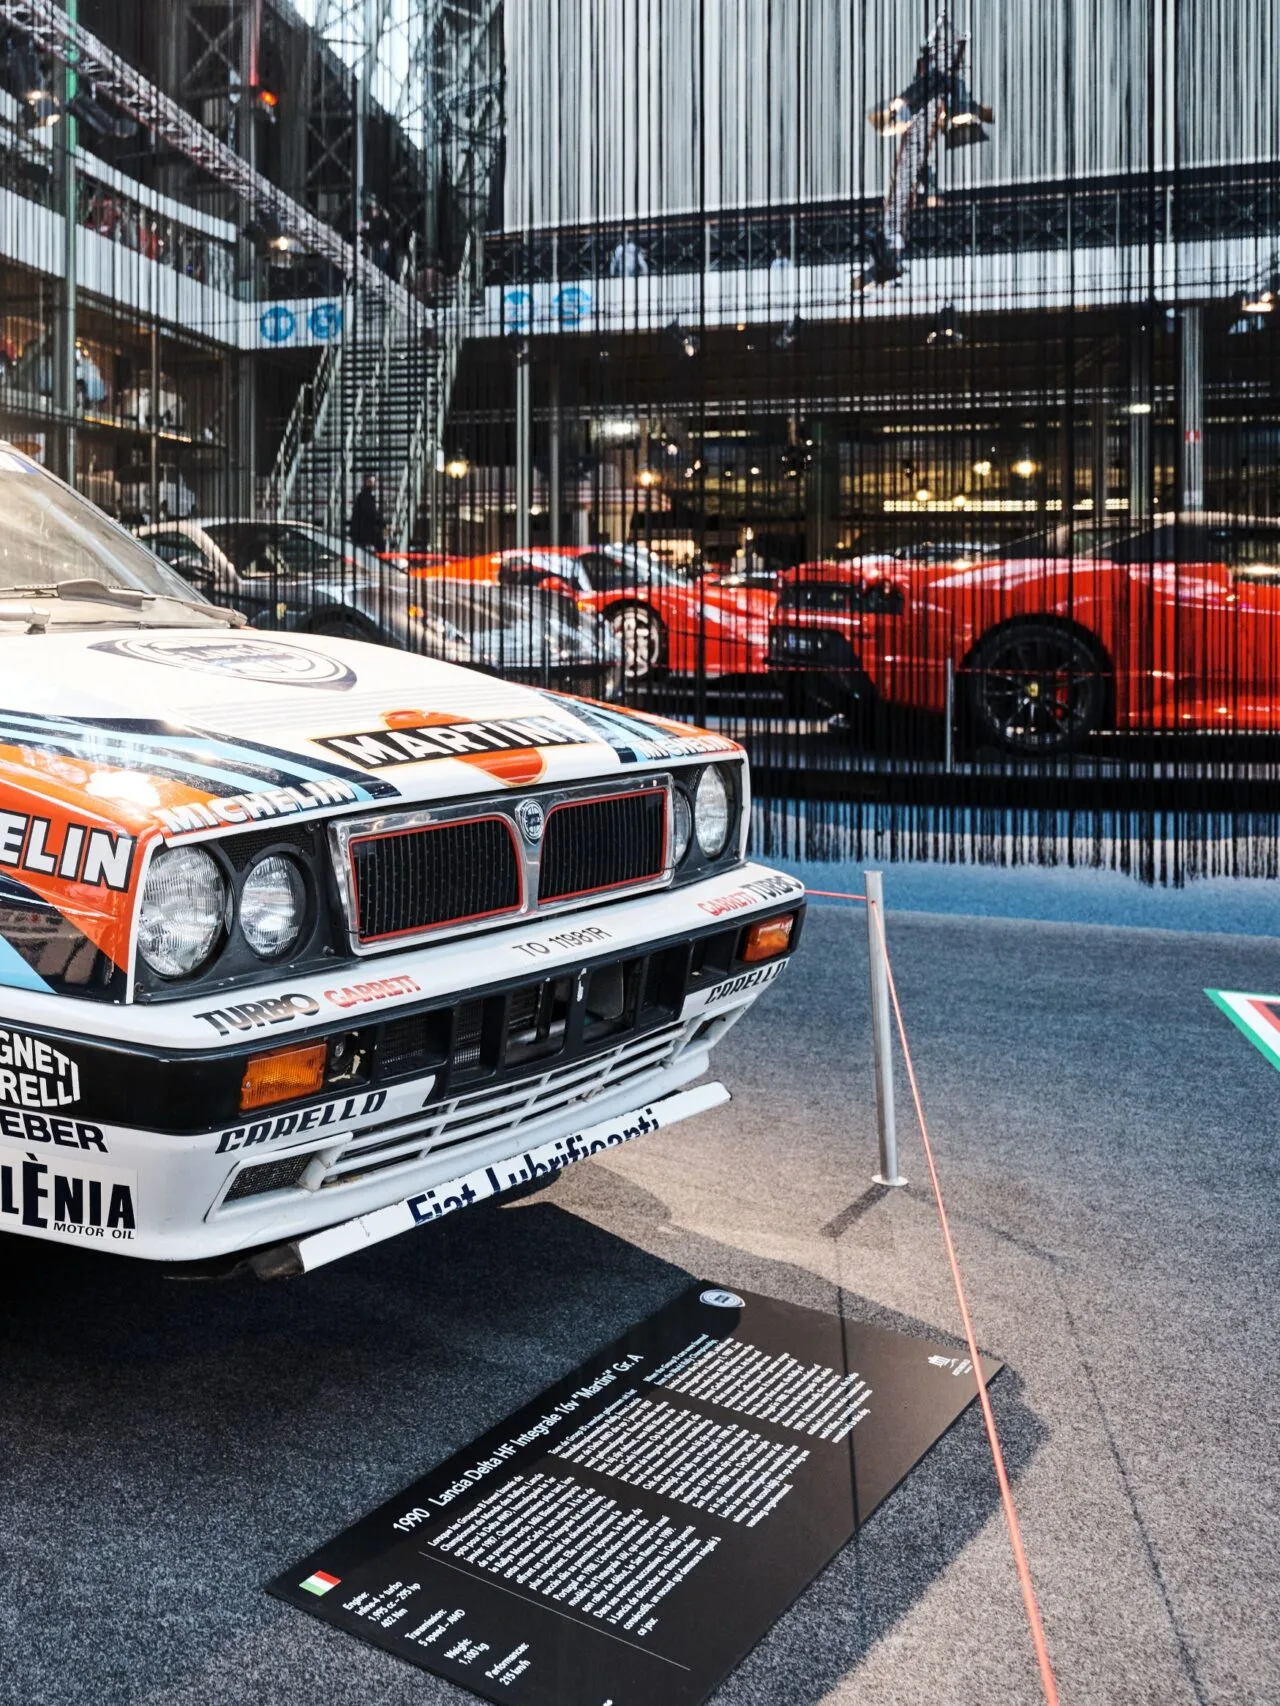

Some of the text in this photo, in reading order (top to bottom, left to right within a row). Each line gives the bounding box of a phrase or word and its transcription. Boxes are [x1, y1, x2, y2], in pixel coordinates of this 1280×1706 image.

[328, 715, 592, 765] MARTINI
[151, 777, 359, 835] MICHELIN
[511, 940, 552, 958] TO
[193, 974, 423, 1037] TURBO GARRETT
[215, 1090, 388, 1155] CARELLO
[406, 1183, 477, 1224] Fiat
[53, 1221, 135, 1240] MOTOR OIL
[392, 1507, 431, 1532] 1990
[427, 1478, 474, 1507] Lancia
[463, 1457, 503, 1481] Delta
[492, 1442, 517, 1459] HF
[509, 1413, 562, 1447] Integrale
[554, 1399, 580, 1414] 16v
[612, 1361, 635, 1372] Gr.
[626, 1354, 644, 1363] A
[382, 1581, 403, 1596] turbo
[342, 1591, 370, 1611] Engine:
[367, 1605, 389, 1622] 1,995
[404, 1608, 448, 1640] Transmission:
[425, 1624, 447, 1643] speed
[443, 1638, 473, 1659] Weight:
[458, 1648, 480, 1665] 1,100
[484, 1642, 530, 1679] Performances:
[509, 1659, 531, 1676] km/h
